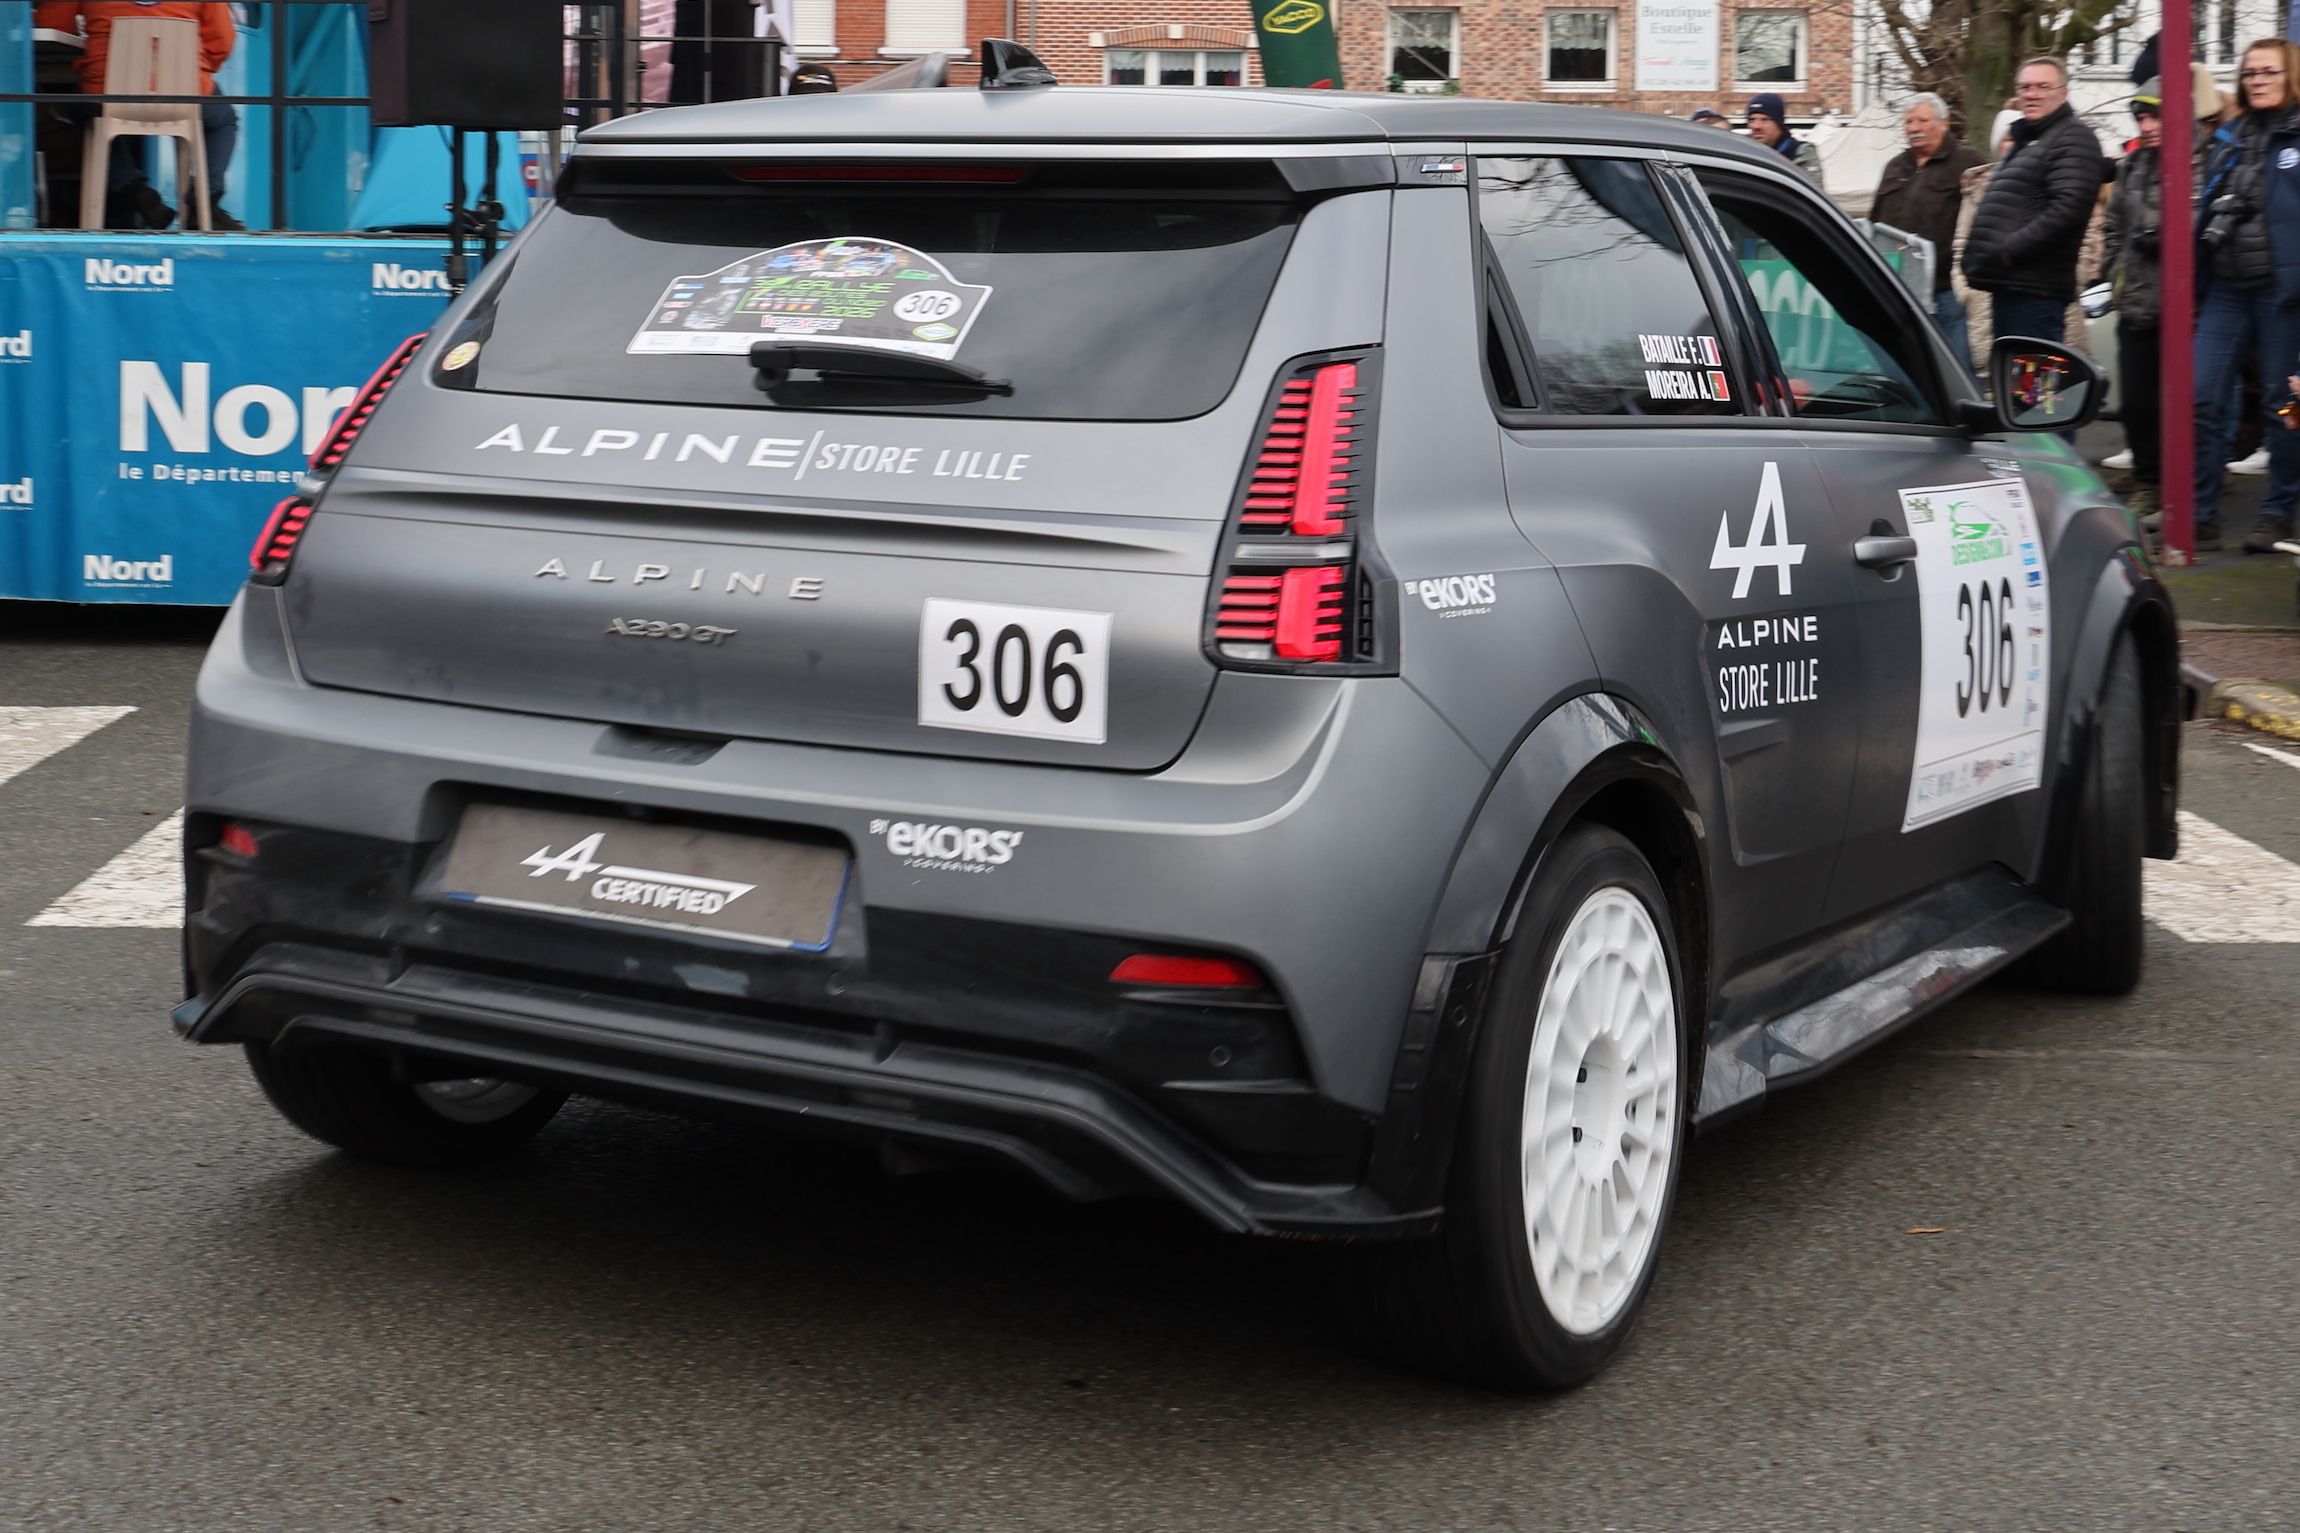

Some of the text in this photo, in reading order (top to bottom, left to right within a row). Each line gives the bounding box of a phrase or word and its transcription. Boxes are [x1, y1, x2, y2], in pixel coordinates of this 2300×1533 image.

[85, 258, 174, 285] Nord
[820, 306, 880, 319] 2026
[903, 295, 954, 315] 306
[0, 330, 32, 356] rd
[1639, 335, 1704, 364] BATAILLE F.
[1645, 370, 1712, 399] MOREIRA A.
[119, 360, 360, 456] Nor
[474, 422, 1031, 482] ALPINE STORE LILLE
[119, 462, 306, 485] le Départemen
[0, 477, 34, 504] rd
[83, 555, 172, 581] Nord
[535, 557, 824, 600] ALPINE
[1717, 616, 1818, 649] ALPINE
[1956, 576, 2015, 720] 306
[943, 618, 1084, 723] 306
[1719, 658, 1819, 713] STORE LILLE
[591, 878, 726, 915] CERTIFIED
